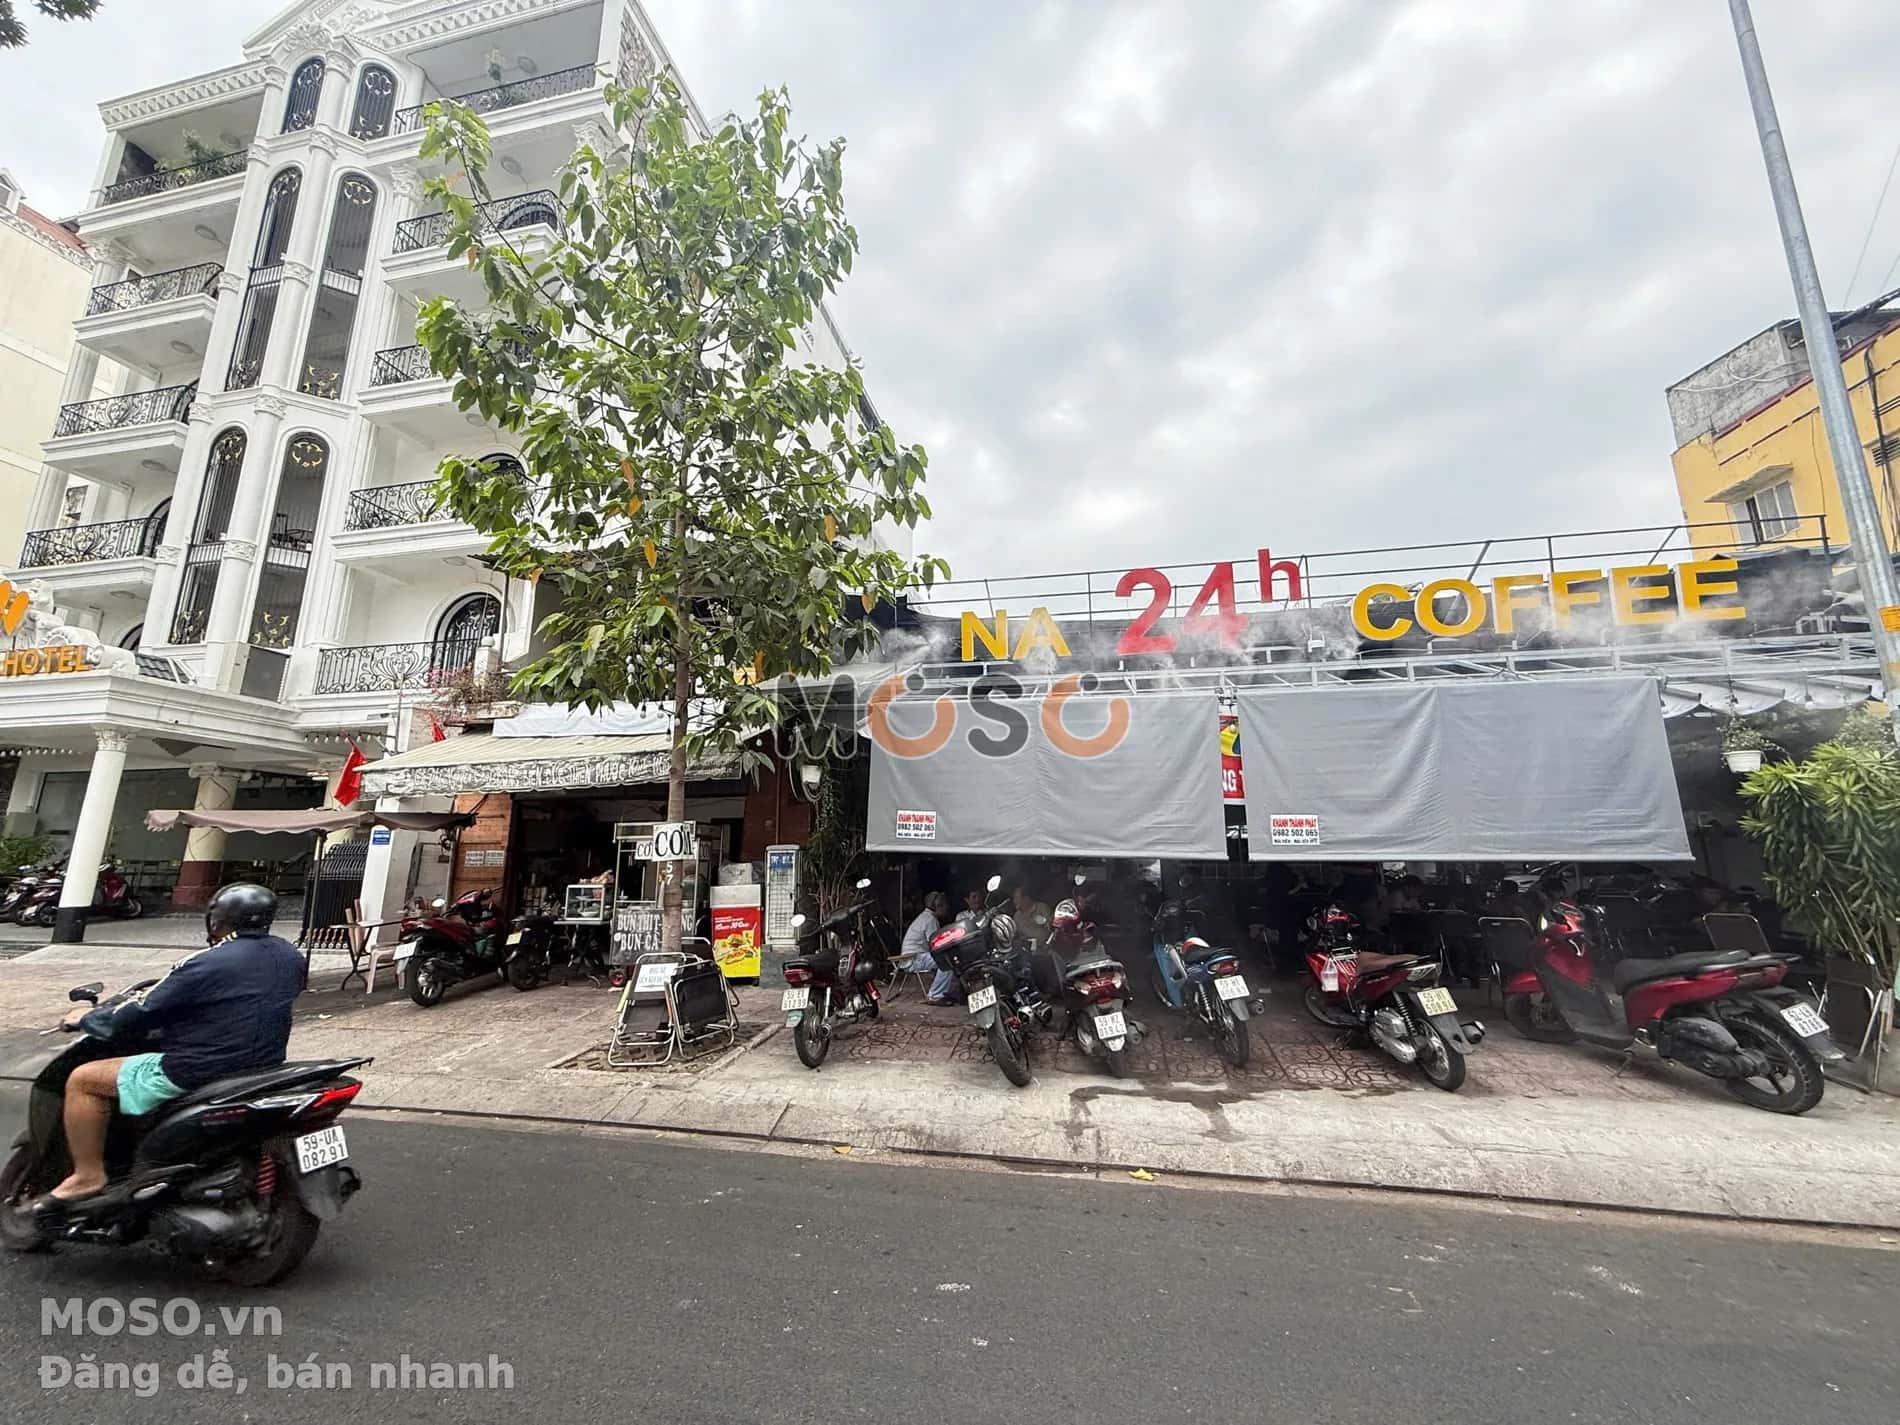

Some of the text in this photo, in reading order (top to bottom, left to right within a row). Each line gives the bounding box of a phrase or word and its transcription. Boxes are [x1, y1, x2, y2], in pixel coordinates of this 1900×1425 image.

[960, 608, 1072, 661] NA
[1350, 558, 1747, 640] COFFEE
[4, 645, 91, 677] HOTEL
